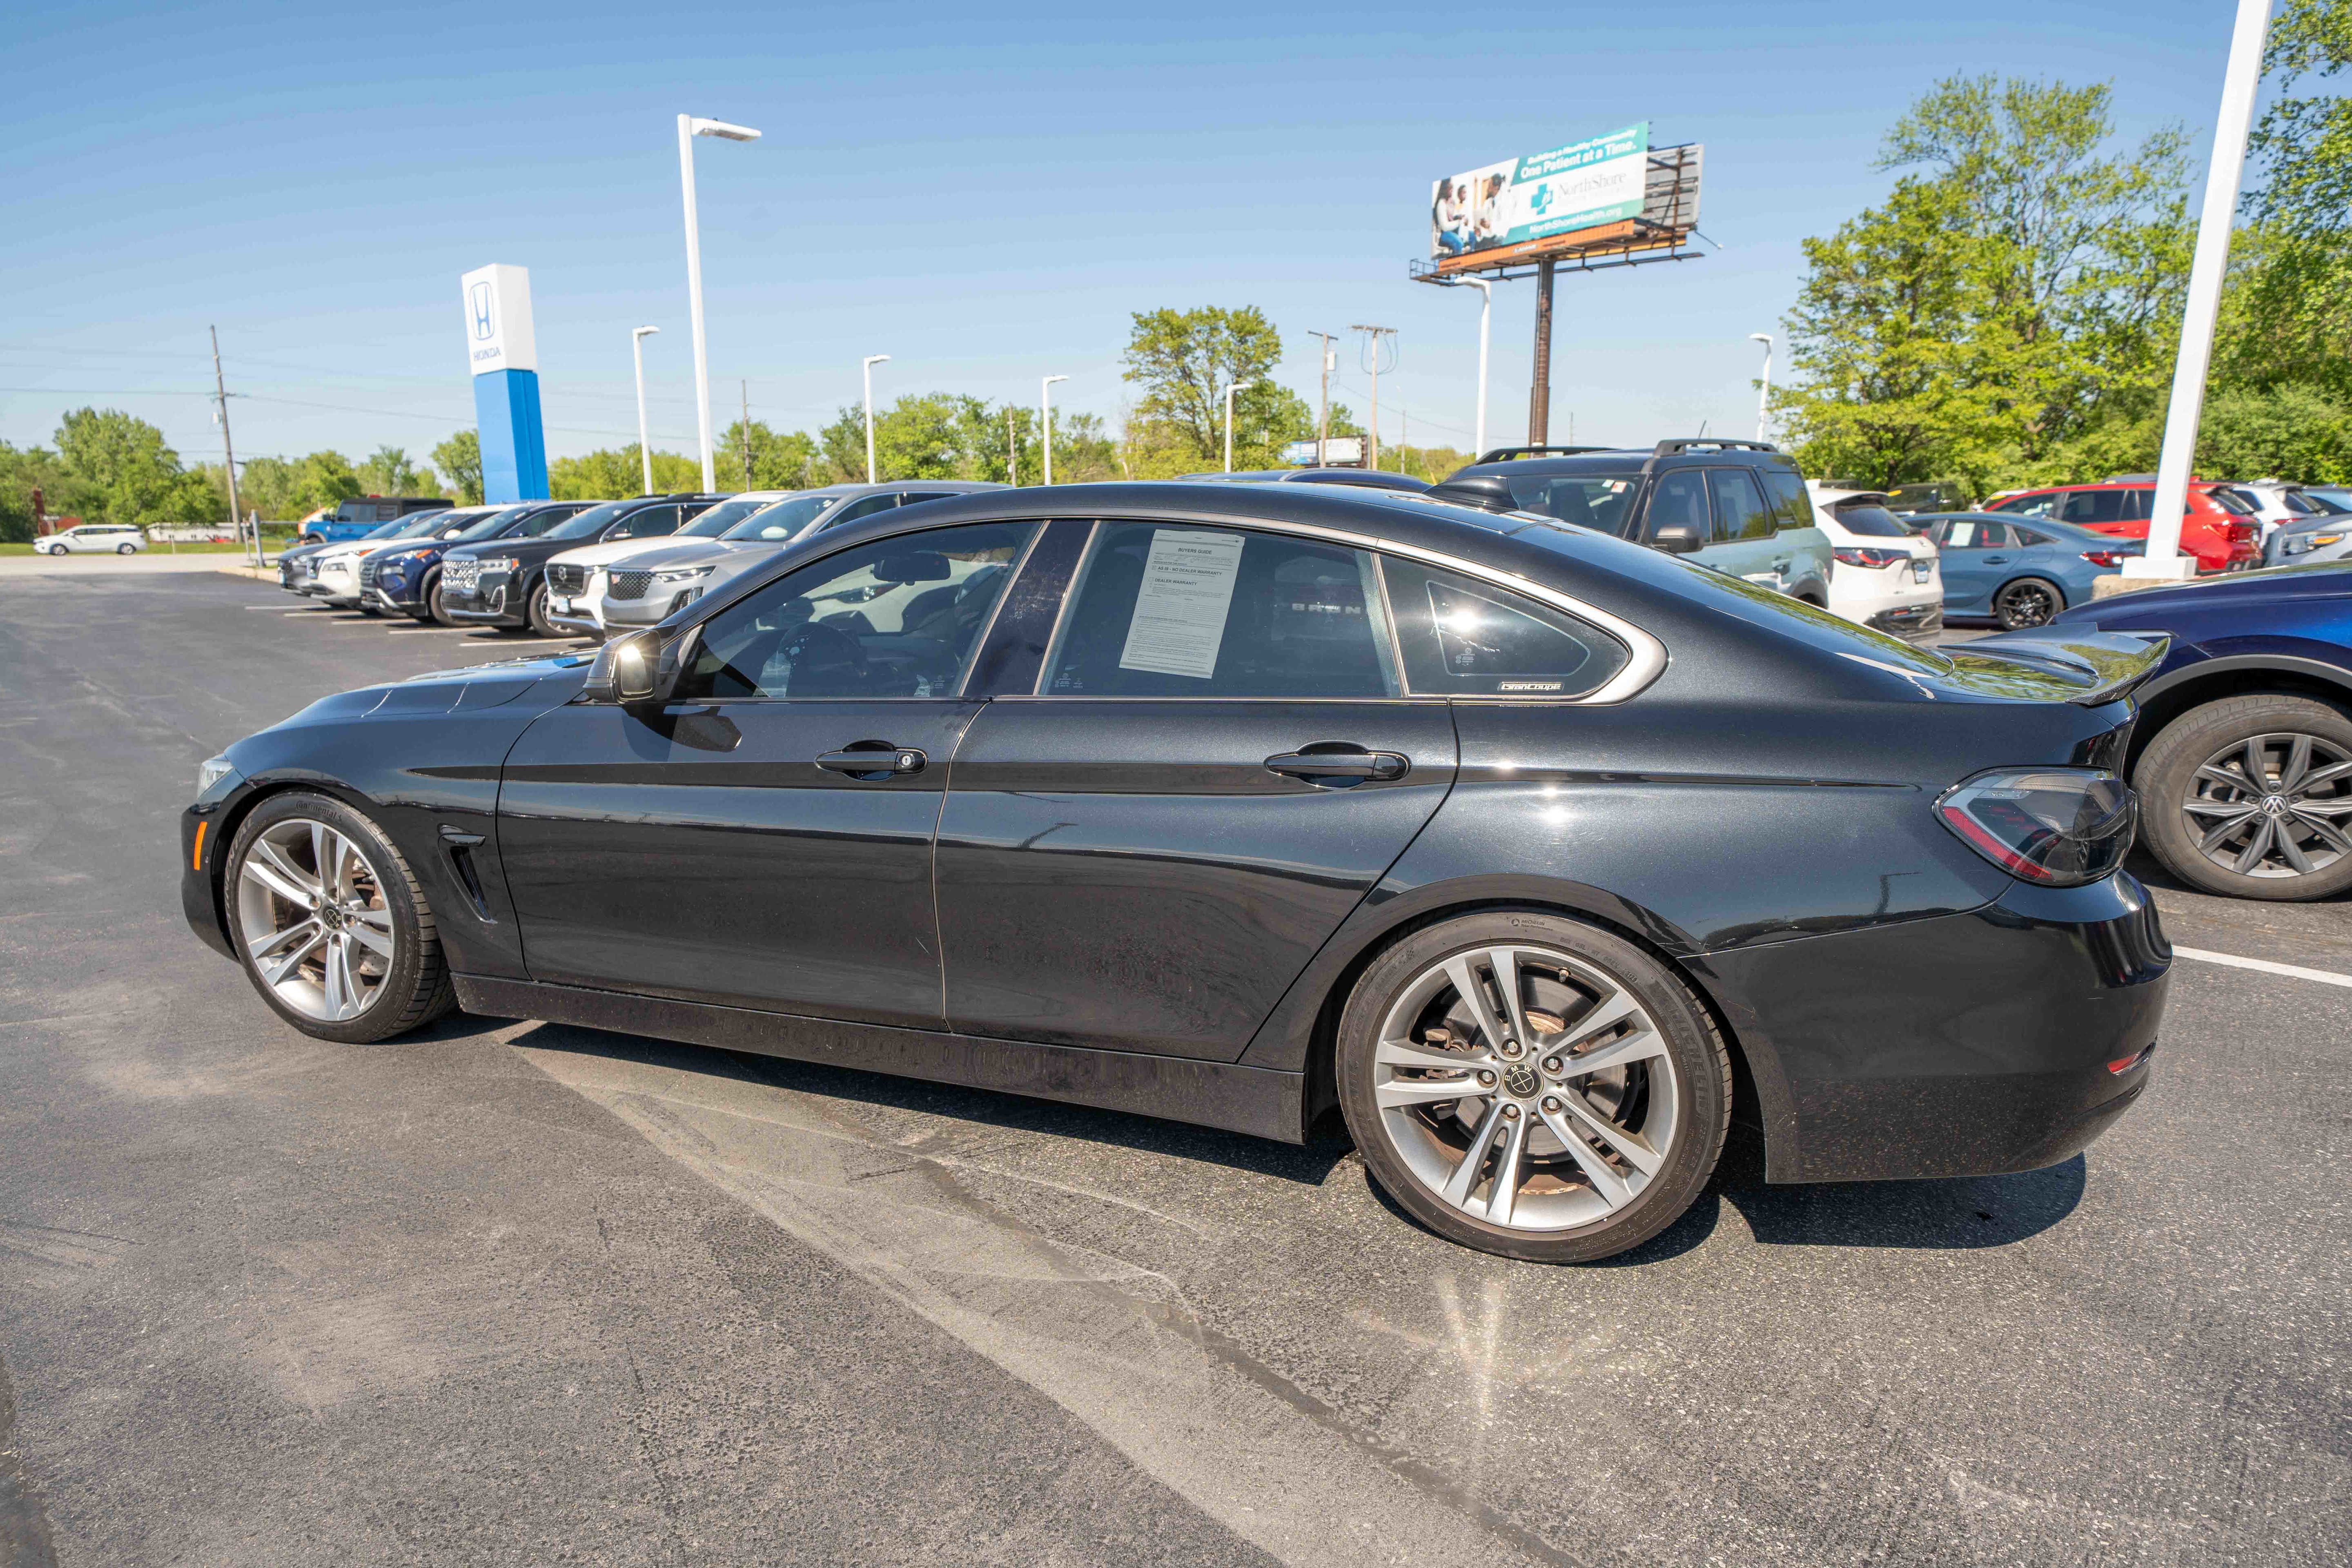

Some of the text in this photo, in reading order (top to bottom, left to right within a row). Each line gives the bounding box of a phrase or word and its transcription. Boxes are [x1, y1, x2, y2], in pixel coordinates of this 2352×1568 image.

[1521, 166, 1542, 179] One
[1544, 153, 1581, 172] Patient
[1582, 149, 1595, 162] at
[1605, 140, 1637, 156] Time.
[1558, 173, 1626, 195] NorthShore
[473, 347, 501, 362] HONDA
[295, 800, 337, 819] Continental
[1505, 1065, 1532, 1082] BMW
